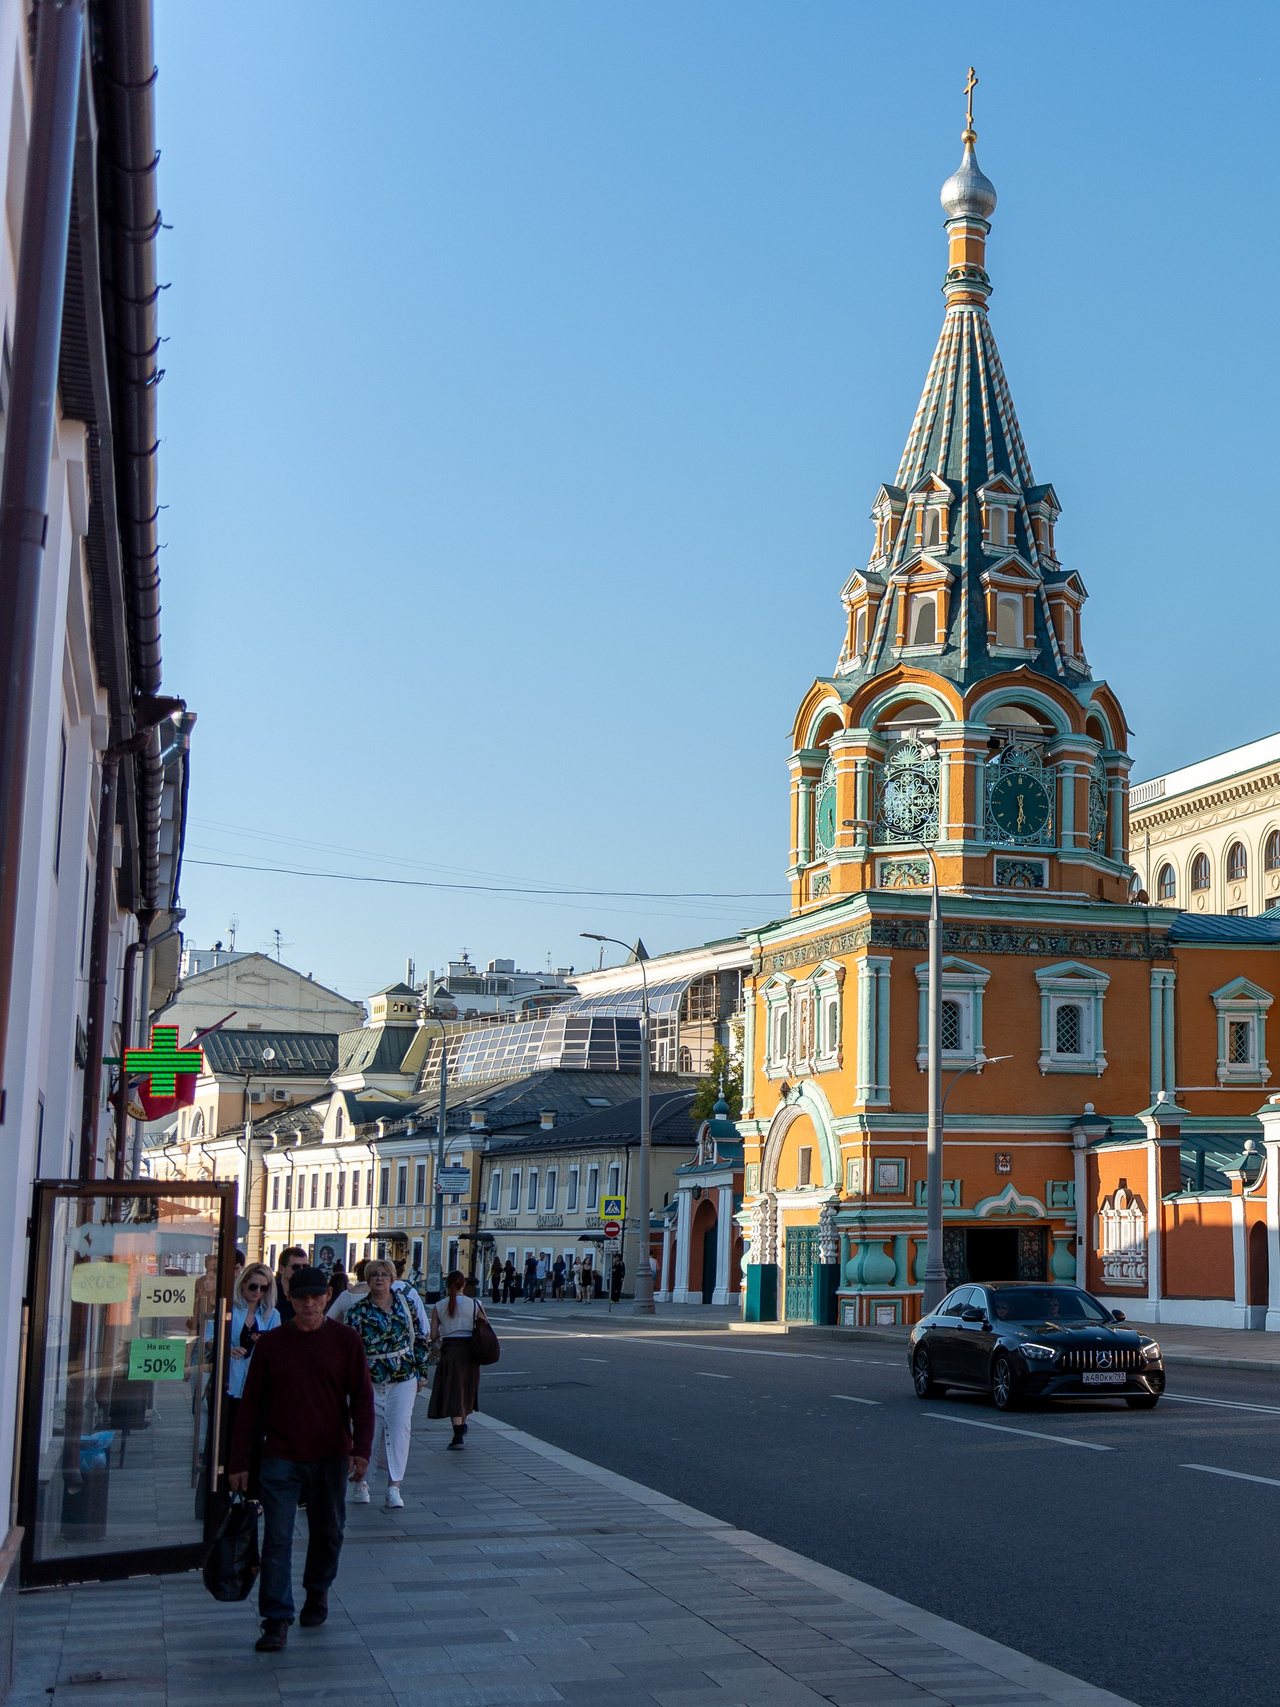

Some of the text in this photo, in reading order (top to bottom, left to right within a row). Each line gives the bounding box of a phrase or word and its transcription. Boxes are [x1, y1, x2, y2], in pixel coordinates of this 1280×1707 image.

[146, 1289, 186, 1303] -50%
[147, 1343, 157, 1351] На
[137, 1359, 177, 1373] -50%
